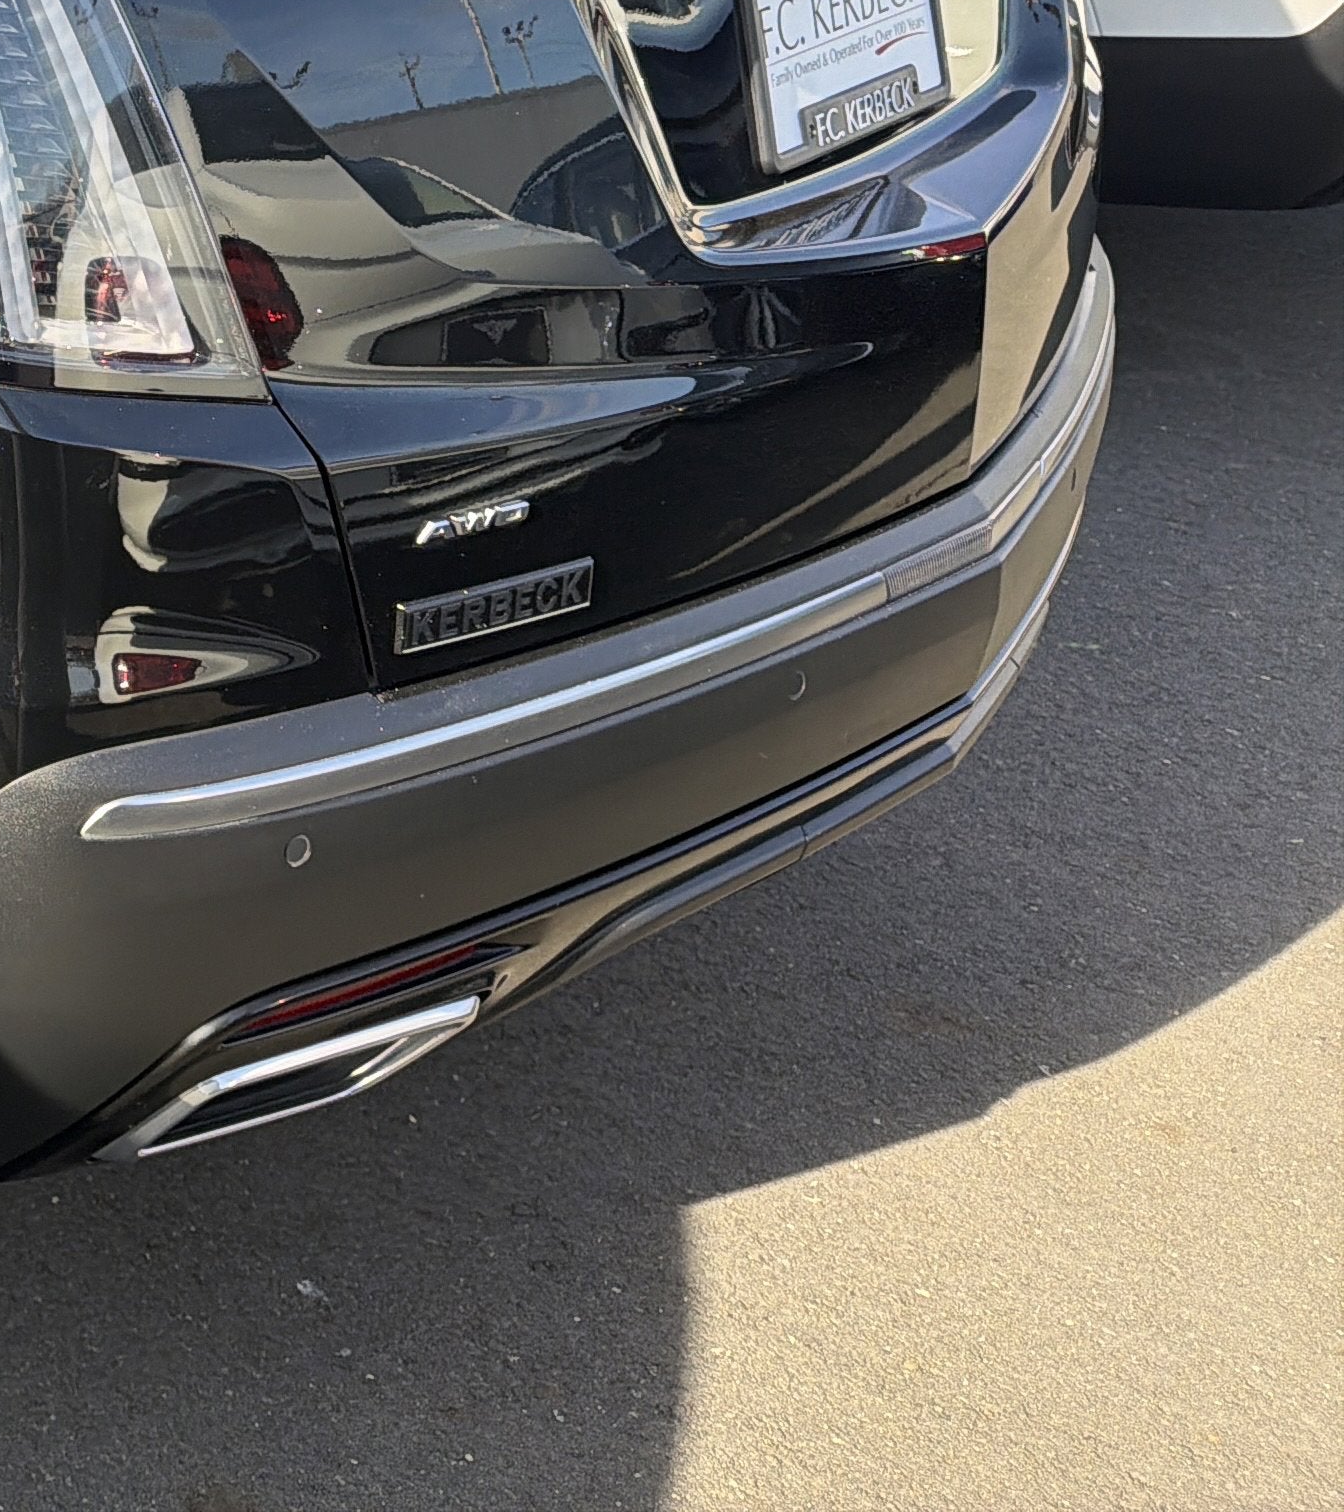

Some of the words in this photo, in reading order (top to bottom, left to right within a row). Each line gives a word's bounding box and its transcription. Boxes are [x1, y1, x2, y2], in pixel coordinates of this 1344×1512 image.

[795, 54, 821, 78] Owned
[829, 36, 862, 64] Operated
[875, 29, 892, 44] Over
[907, 17, 925, 32] Years
[814, 107, 845, 147] F.C.
[845, 76, 916, 136] KERBECK
[412, 569, 586, 646] KERBECK
